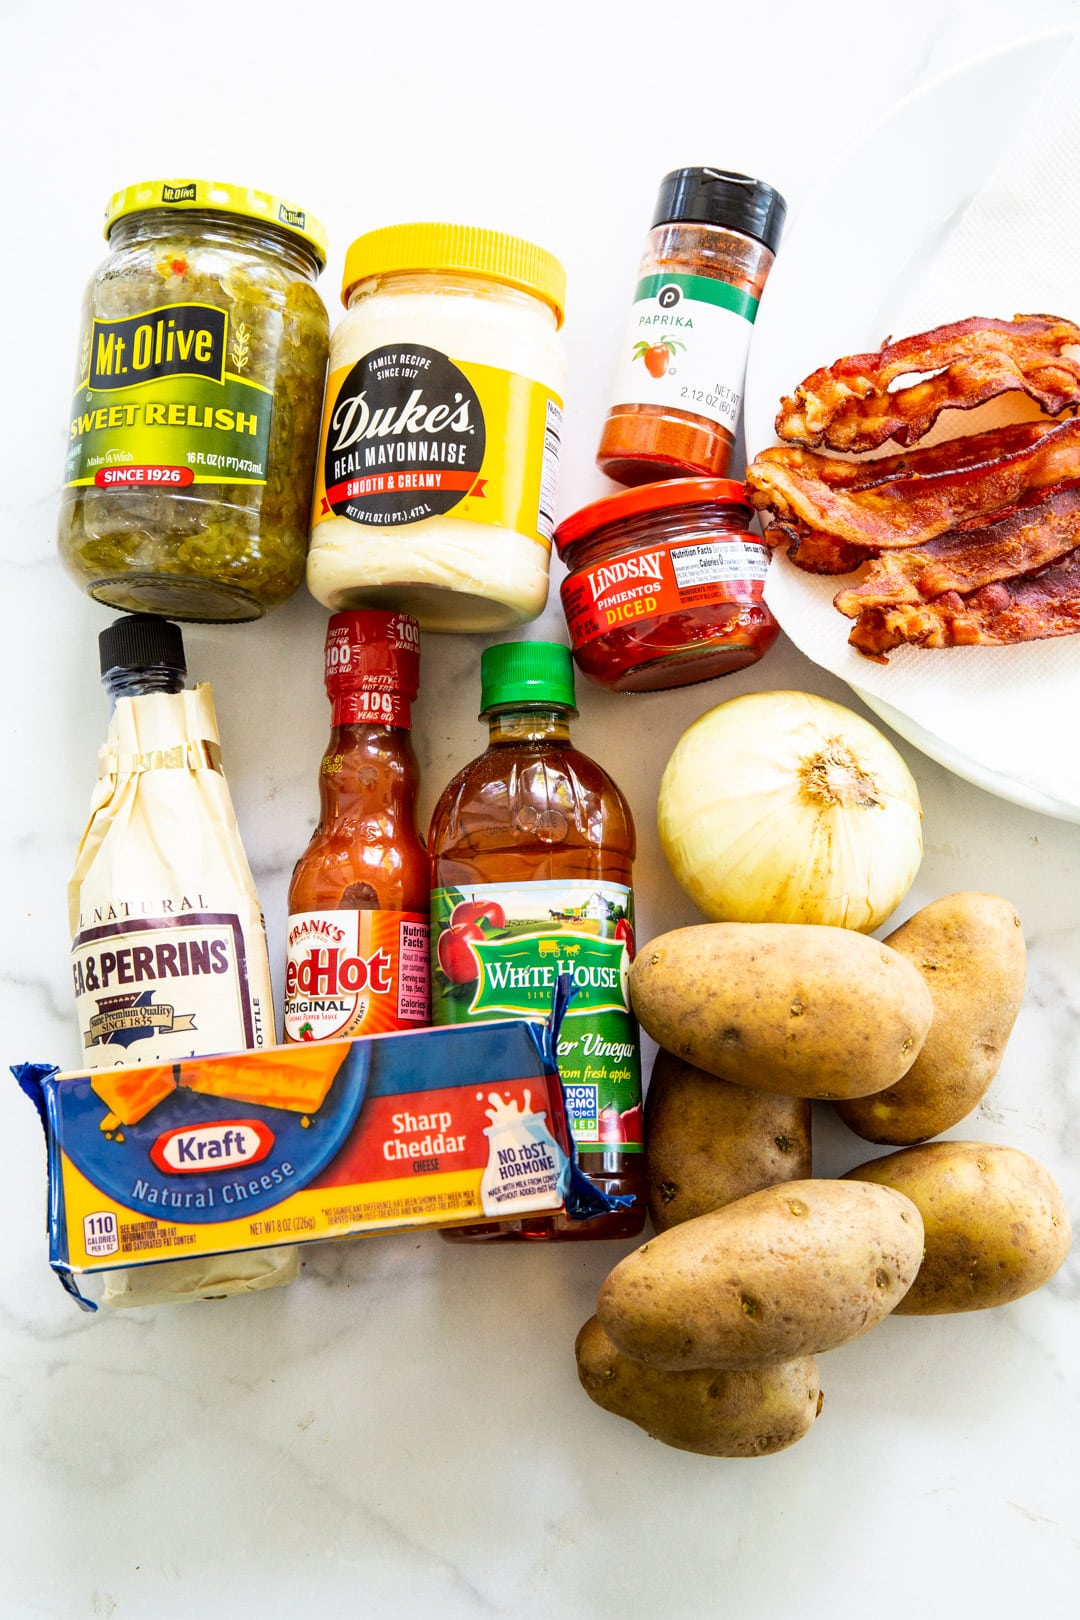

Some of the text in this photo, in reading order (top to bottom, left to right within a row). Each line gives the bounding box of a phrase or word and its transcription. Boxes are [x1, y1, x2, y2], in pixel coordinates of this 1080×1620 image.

[639, 314, 694, 329] PAPRIKA
[96, 319, 214, 376] Mt. Olive
[368, 354, 432, 371] FAMILY RECIPE
[377, 367, 419, 381] SINCE 1917
[680, 386, 704, 402] 2.12
[705, 394, 719, 408] OZ
[714, 384, 731, 399] NET
[70, 403, 258, 440] SWEET RELISH
[186, 452, 196, 463] 16
[334, 441, 467, 480] REAL MAYONNAISE
[104, 469, 181, 482] SINCE 1926
[347, 473, 442, 496] SMOOTH & CREAMY
[345, 504, 358, 518] NET
[373, 513, 383, 523] OZ
[671, 548, 697, 560] Nutrition
[697, 546, 713, 555] Facts
[597, 582, 662, 611] PIMIENTOS
[605, 597, 658, 624] DICED
[396, 622, 419, 644] 100
[326, 645, 351, 667] 100
[338, 664, 353, 673] OLD
[362, 674, 393, 684] PRETTY
[360, 691, 393, 713] 100
[357, 711, 380, 720] YEARS
[93, 894, 208, 923] NATURAL
[289, 919, 346, 947] FRANK'S
[403, 936, 424, 948] Facts
[402, 952, 413, 961] About
[286, 947, 391, 997] edHot
[401, 973, 418, 985] Serving
[401, 998, 426, 1009] Calories
[527, 991, 551, 999] SINC
[105, 1008, 138, 1021] Premium
[140, 1005, 171, 1018] Quality
[285, 1000, 351, 1014] ORIGINAL
[409, 1009, 425, 1017] serving
[101, 1016, 152, 1032] SINCE 1835
[253, 997, 264, 1048] OTTLE
[580, 1033, 636, 1064] Vinegar
[583, 1064, 607, 1083] fresh
[609, 1066, 632, 1084] apples
[566, 1088, 594, 1098] NON
[565, 1098, 595, 1109] GMO
[571, 1109, 595, 1118] roject
[392, 1111, 452, 1135] Sharp
[178, 1130, 246, 1162] Kraft
[383, 1133, 466, 1161] Cheddar
[497, 1141, 547, 1165] NO rbST
[412, 1158, 440, 1173] CHEESE
[499, 1156, 555, 1180] HORMONE
[131, 1160, 295, 1208] Natural Cheese
[488, 1186, 502, 1198] MADE
[502, 1182, 515, 1192] WITH
[515, 1180, 527, 1189] MILK
[528, 1177, 543, 1186] FROM
[496, 1190, 518, 1203] WITHOUT
[520, 1186, 536, 1197] ADDED
[88, 1216, 113, 1235] 110
[120, 1220, 158, 1234] SEE NUTRITION
[249, 1215, 317, 1236] NET WT 8 OZ (226g)
[87, 1234, 116, 1246] CALORIES
[121, 1227, 177, 1243] INFORMATION FOR FAT
[122, 1234, 197, 1253] AND SATURATED FAT CONTENT
[91, 1245, 102, 1253] PER
[106, 1243, 114, 1251] OZ
